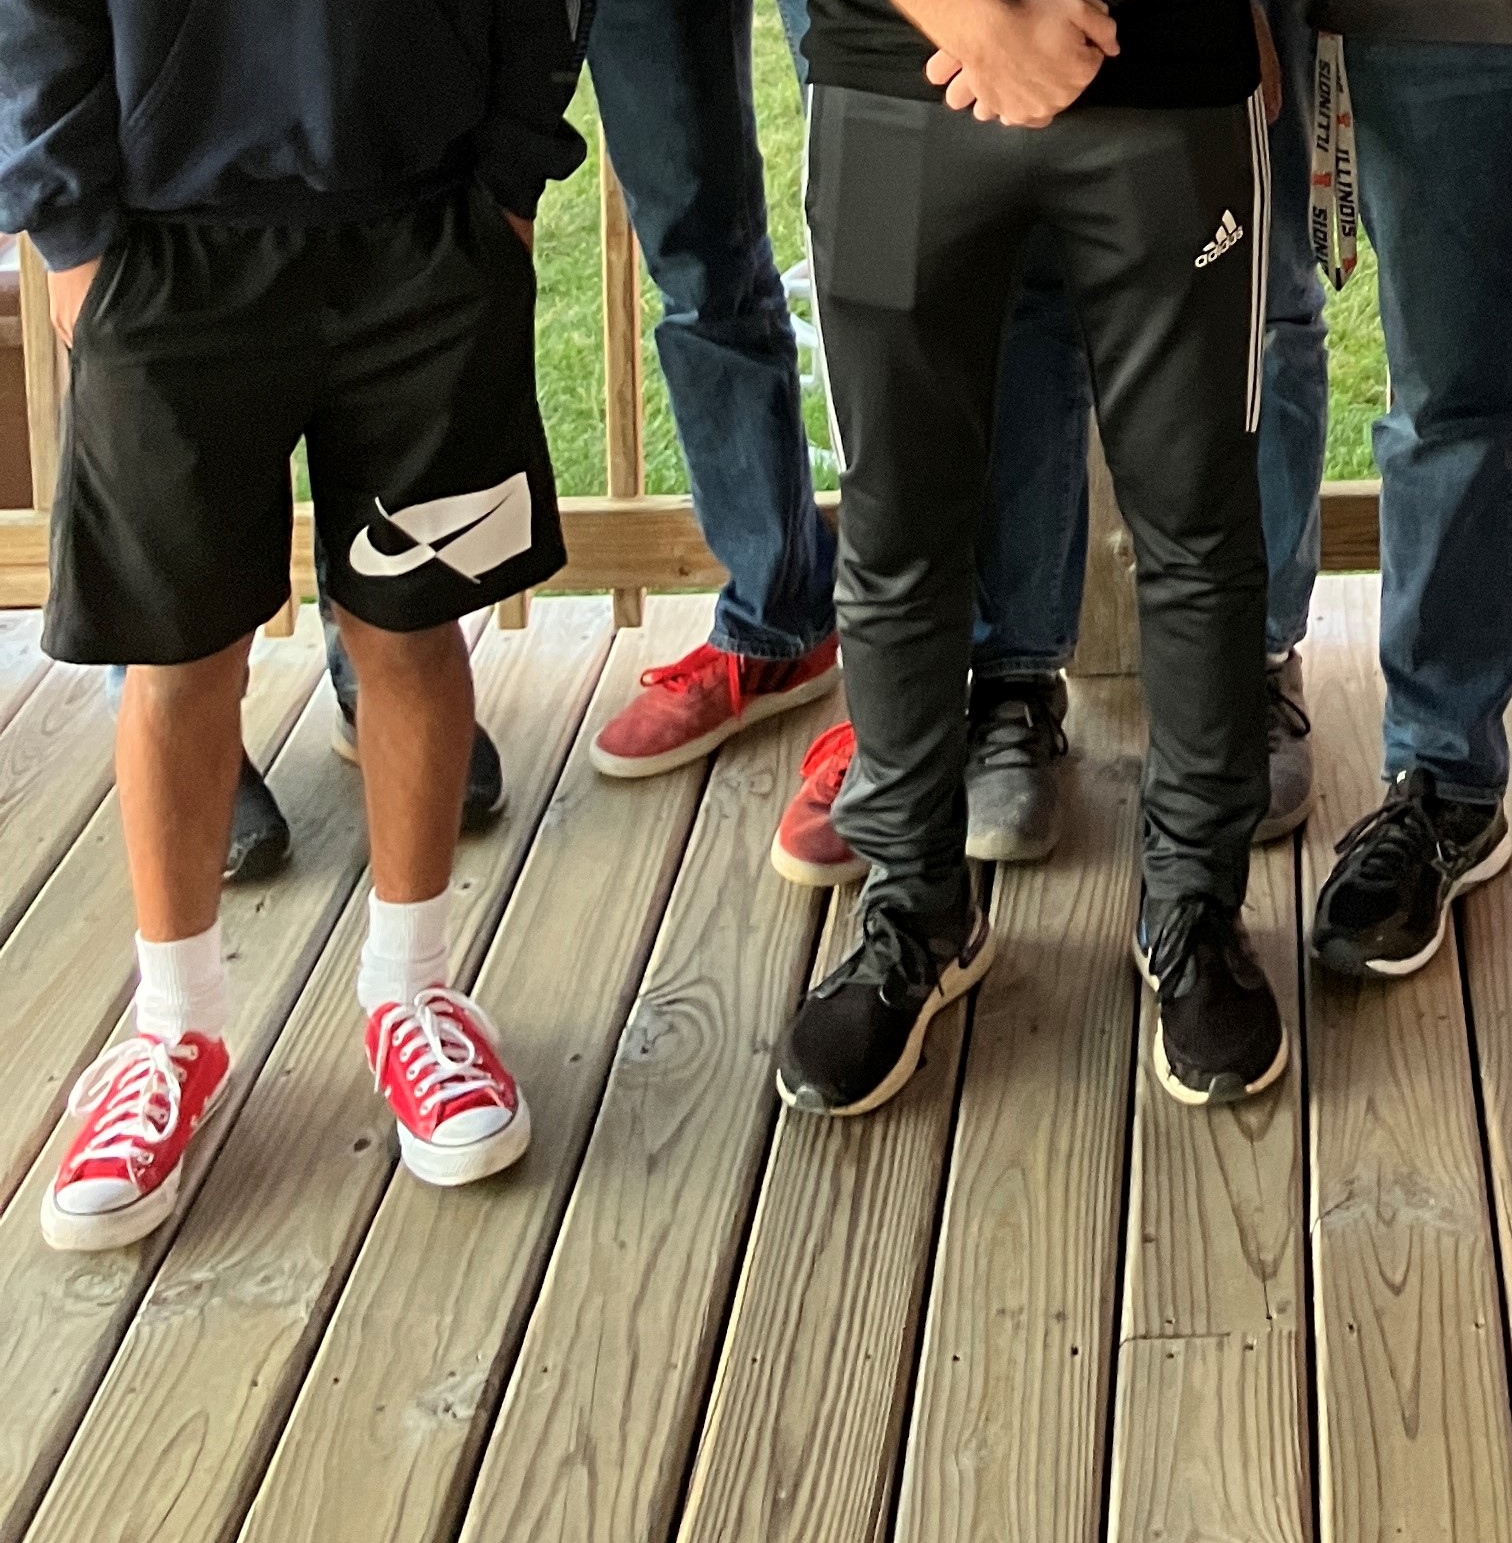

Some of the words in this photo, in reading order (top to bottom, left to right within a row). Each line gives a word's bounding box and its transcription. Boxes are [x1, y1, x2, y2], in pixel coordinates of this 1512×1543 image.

[1316, 59, 1331, 153] ILLINOIS
[1336, 149, 1355, 238] ILLINOIS
[1194, 226, 1244, 268] adidas
